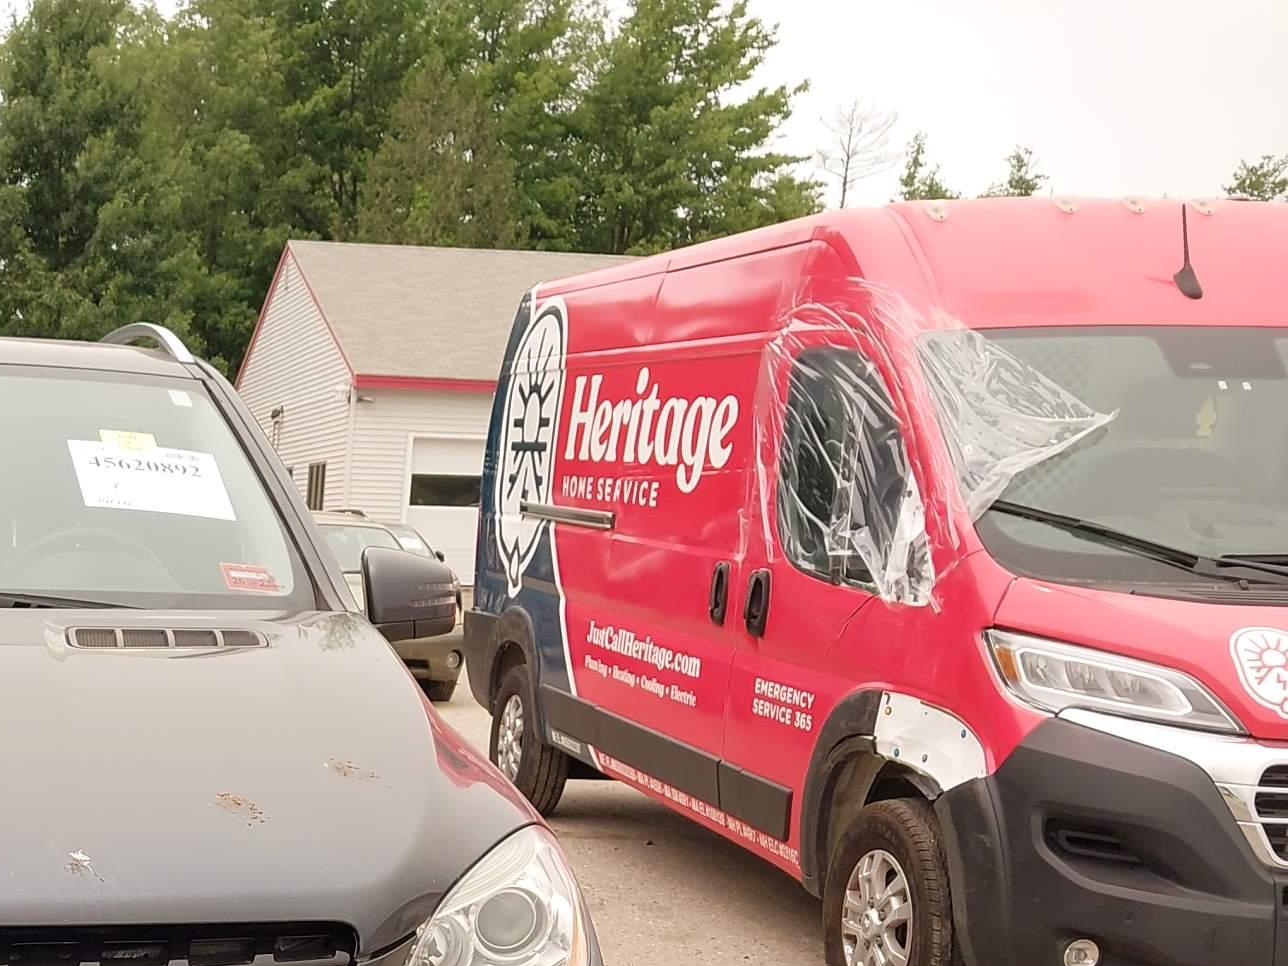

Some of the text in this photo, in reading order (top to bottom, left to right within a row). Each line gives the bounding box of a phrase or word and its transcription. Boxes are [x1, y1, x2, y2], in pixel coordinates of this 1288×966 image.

[565, 367, 739, 493] Heritage
[89, 456, 202, 477] 45620892
[563, 475, 660, 507] HOME SERVICE
[587, 620, 701, 678] JustCallHeritage.com
[612, 663, 636, 688] Heating
[641, 674, 665, 698] Cooling
[670, 684, 697, 707] Electric
[754, 678, 814, 709] EMERGENCY
[752, 697, 813, 731] SERVICE 365
